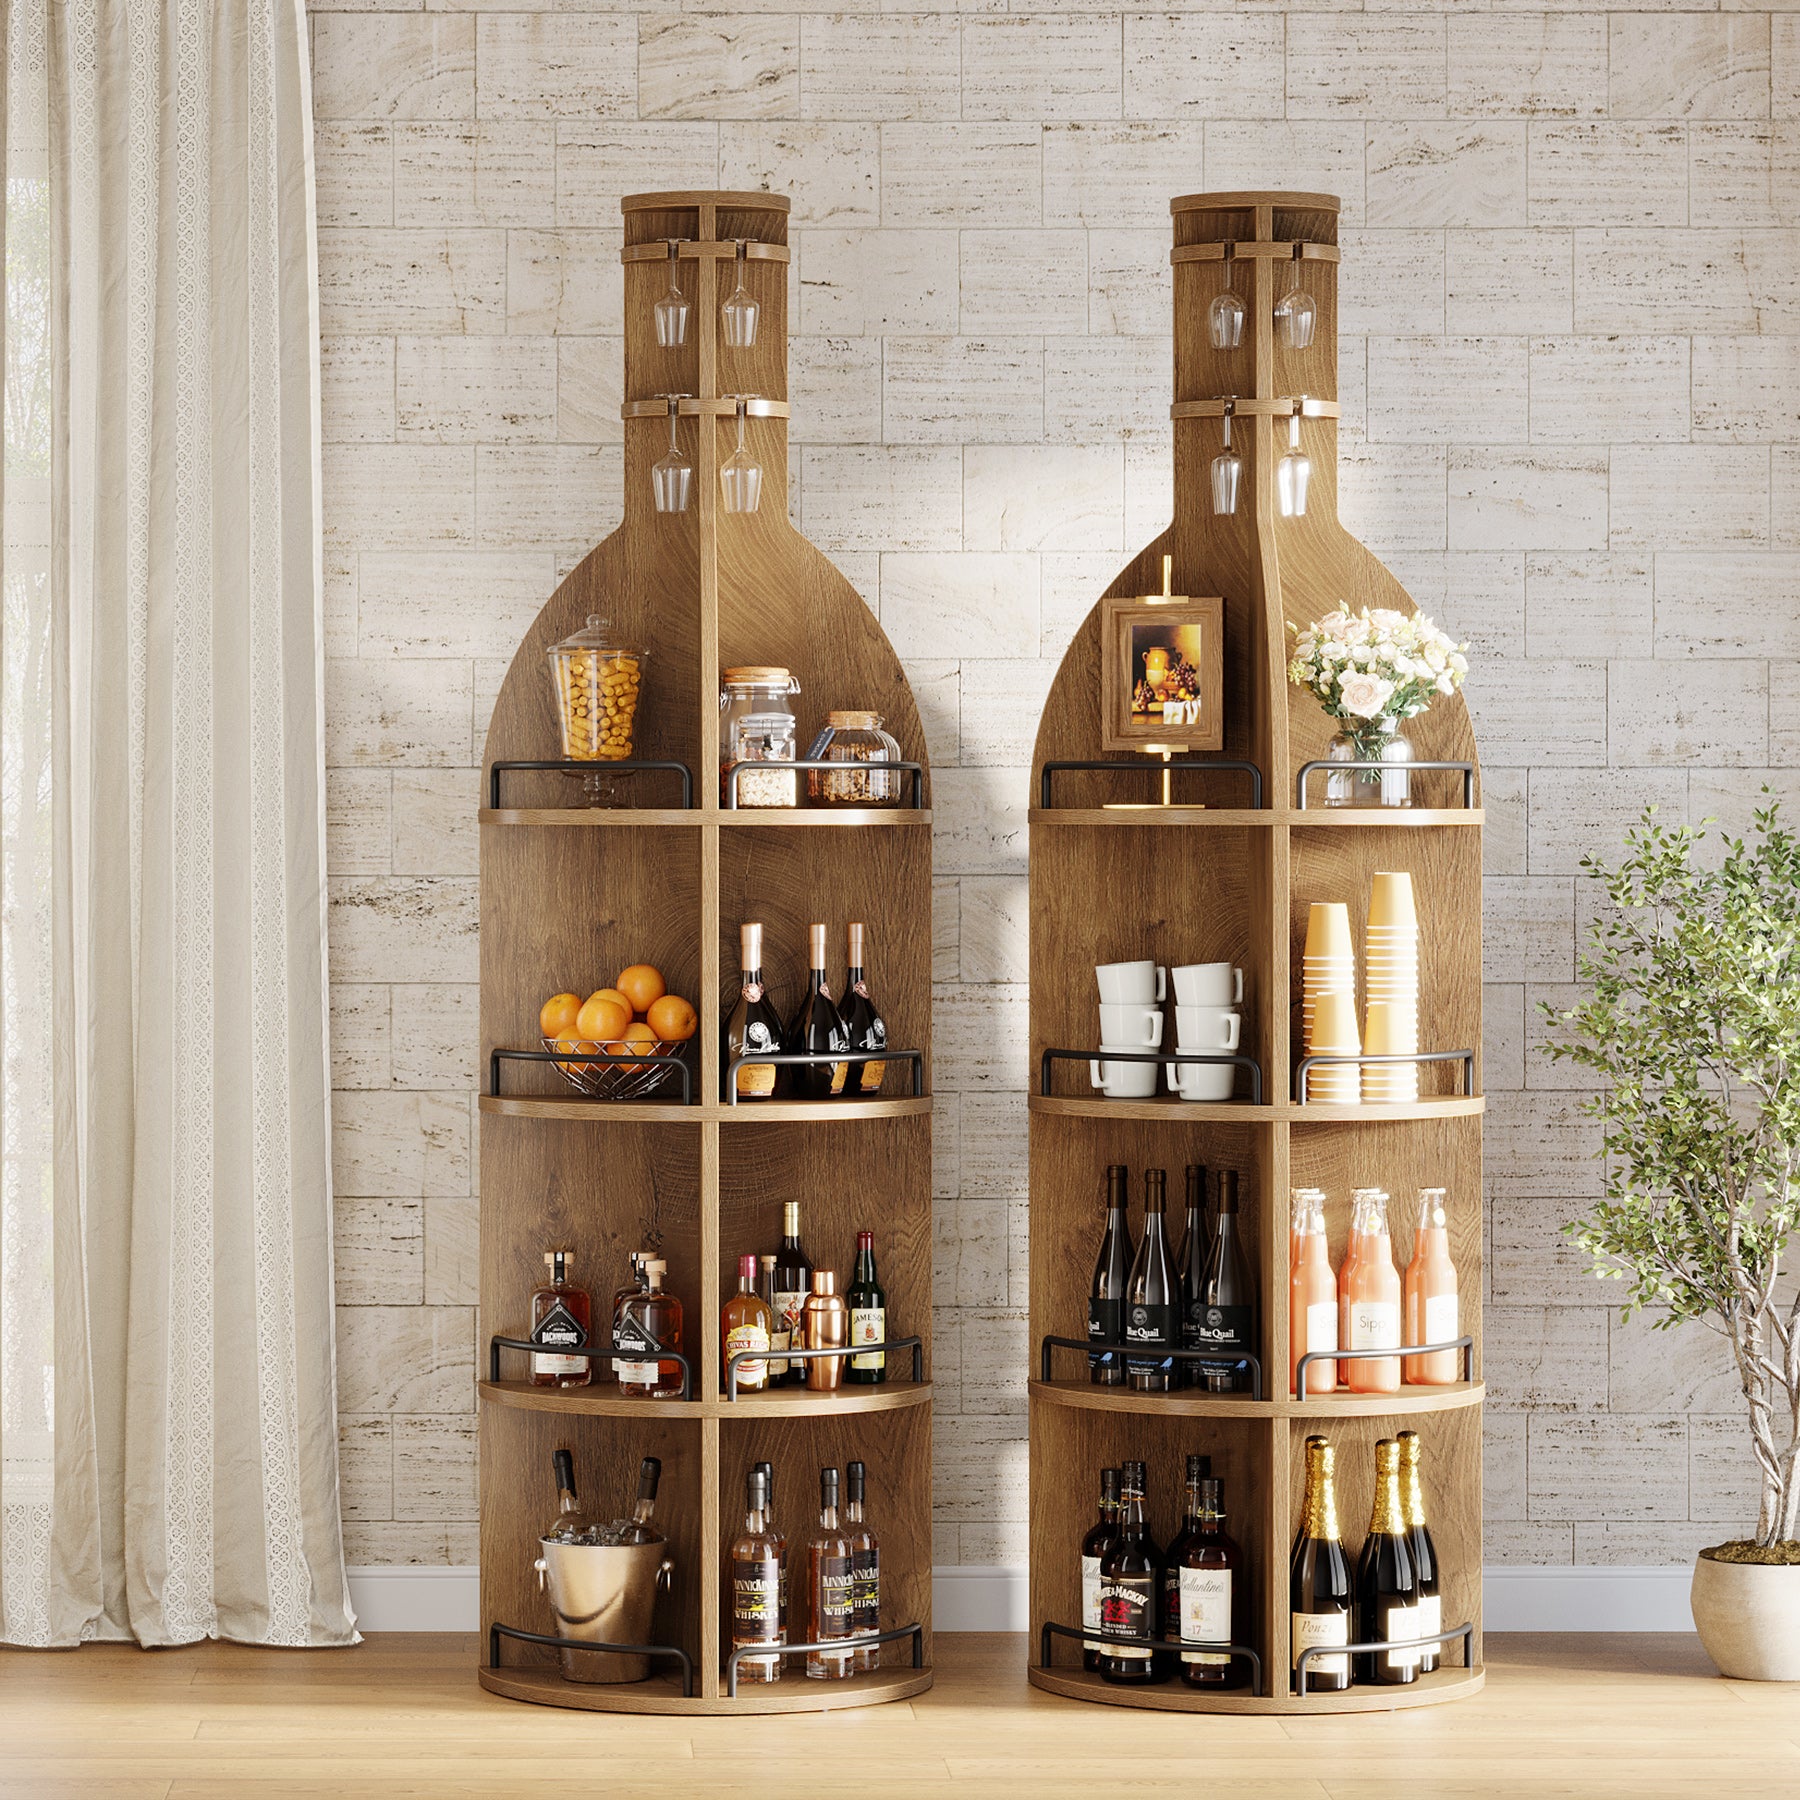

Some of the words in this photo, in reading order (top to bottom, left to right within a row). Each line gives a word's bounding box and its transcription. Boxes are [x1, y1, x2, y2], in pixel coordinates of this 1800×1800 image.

[1138, 1327, 1159, 1339] Quail
[1212, 1328, 1235, 1340] Quail
[1115, 1585, 1149, 1607] MACKAY
